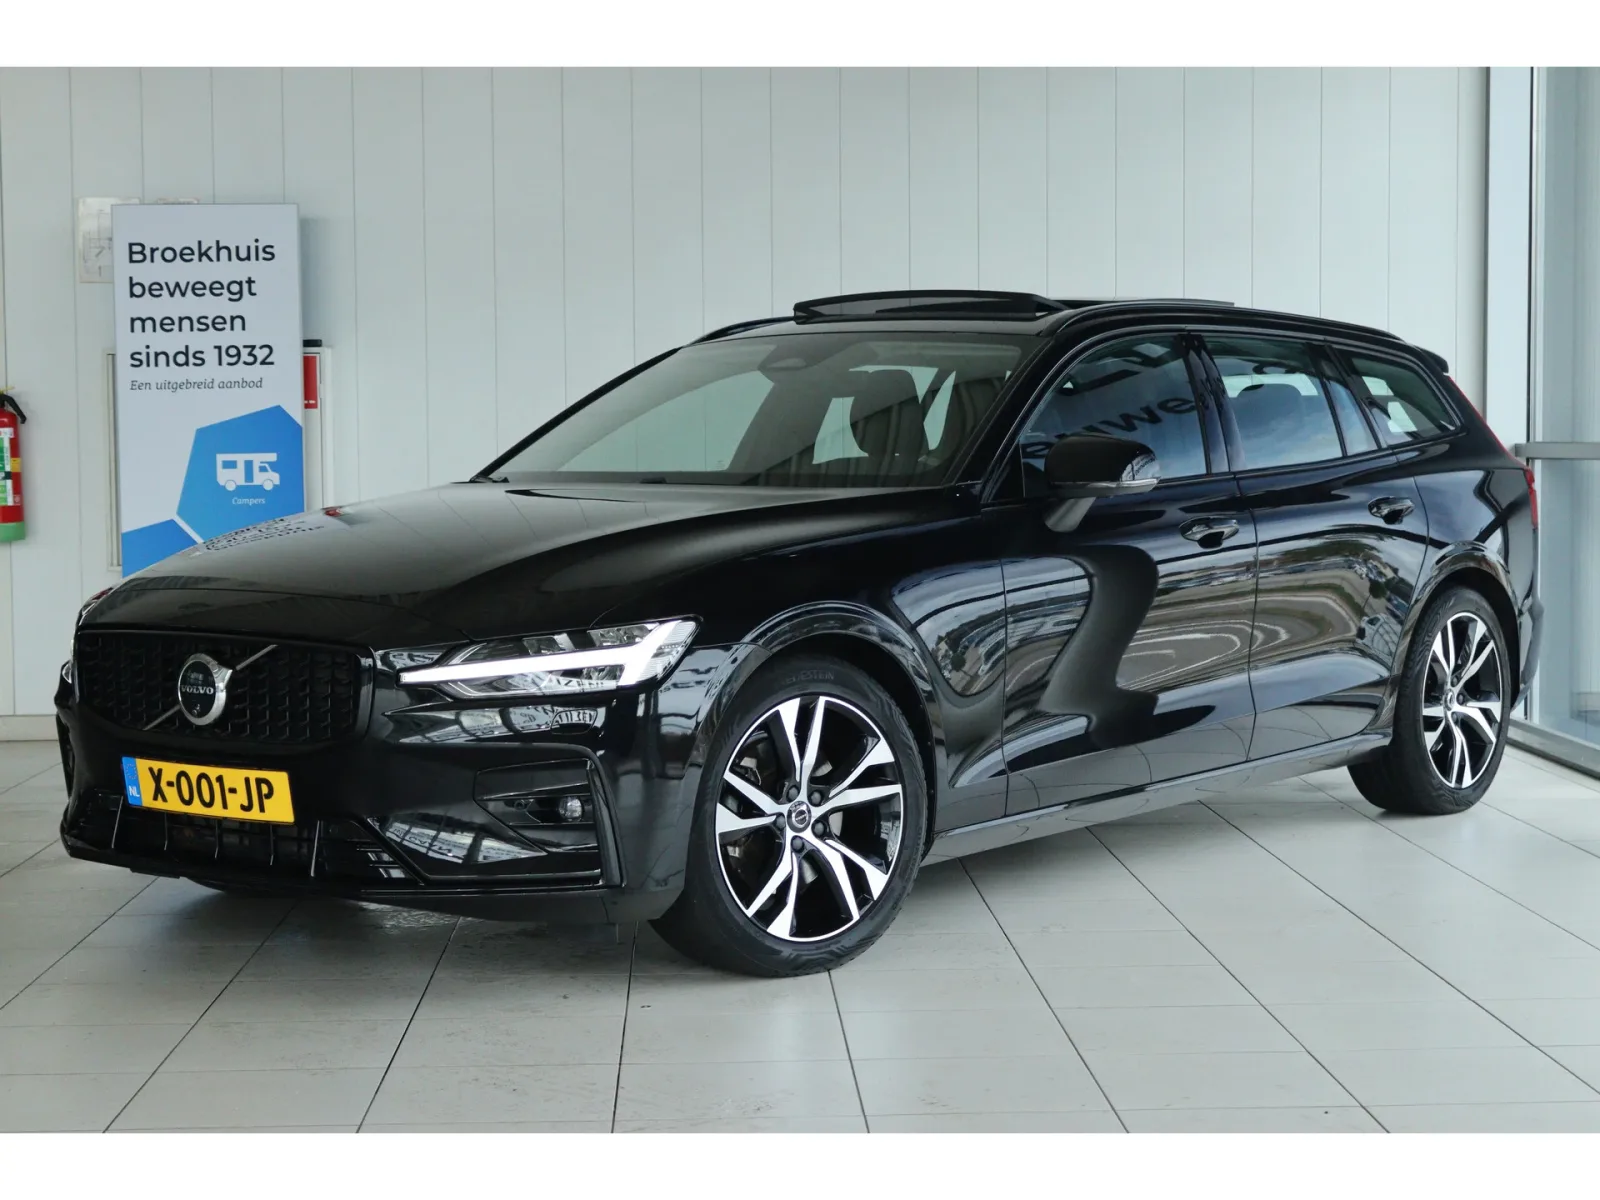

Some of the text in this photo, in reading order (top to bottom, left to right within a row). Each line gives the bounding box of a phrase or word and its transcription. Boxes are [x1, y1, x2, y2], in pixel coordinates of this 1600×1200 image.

[127, 238, 276, 264] Broekhuis
[128, 276, 257, 302] beweegt
[129, 314, 247, 333] mensen
[129, 344, 275, 368] sinds 1932
[129, 377, 263, 393] Een uitgebreid aanbod
[231, 496, 266, 506] Campers
[181, 684, 214, 695] VOLVO
[129, 766, 275, 814] NL X-001-JP
